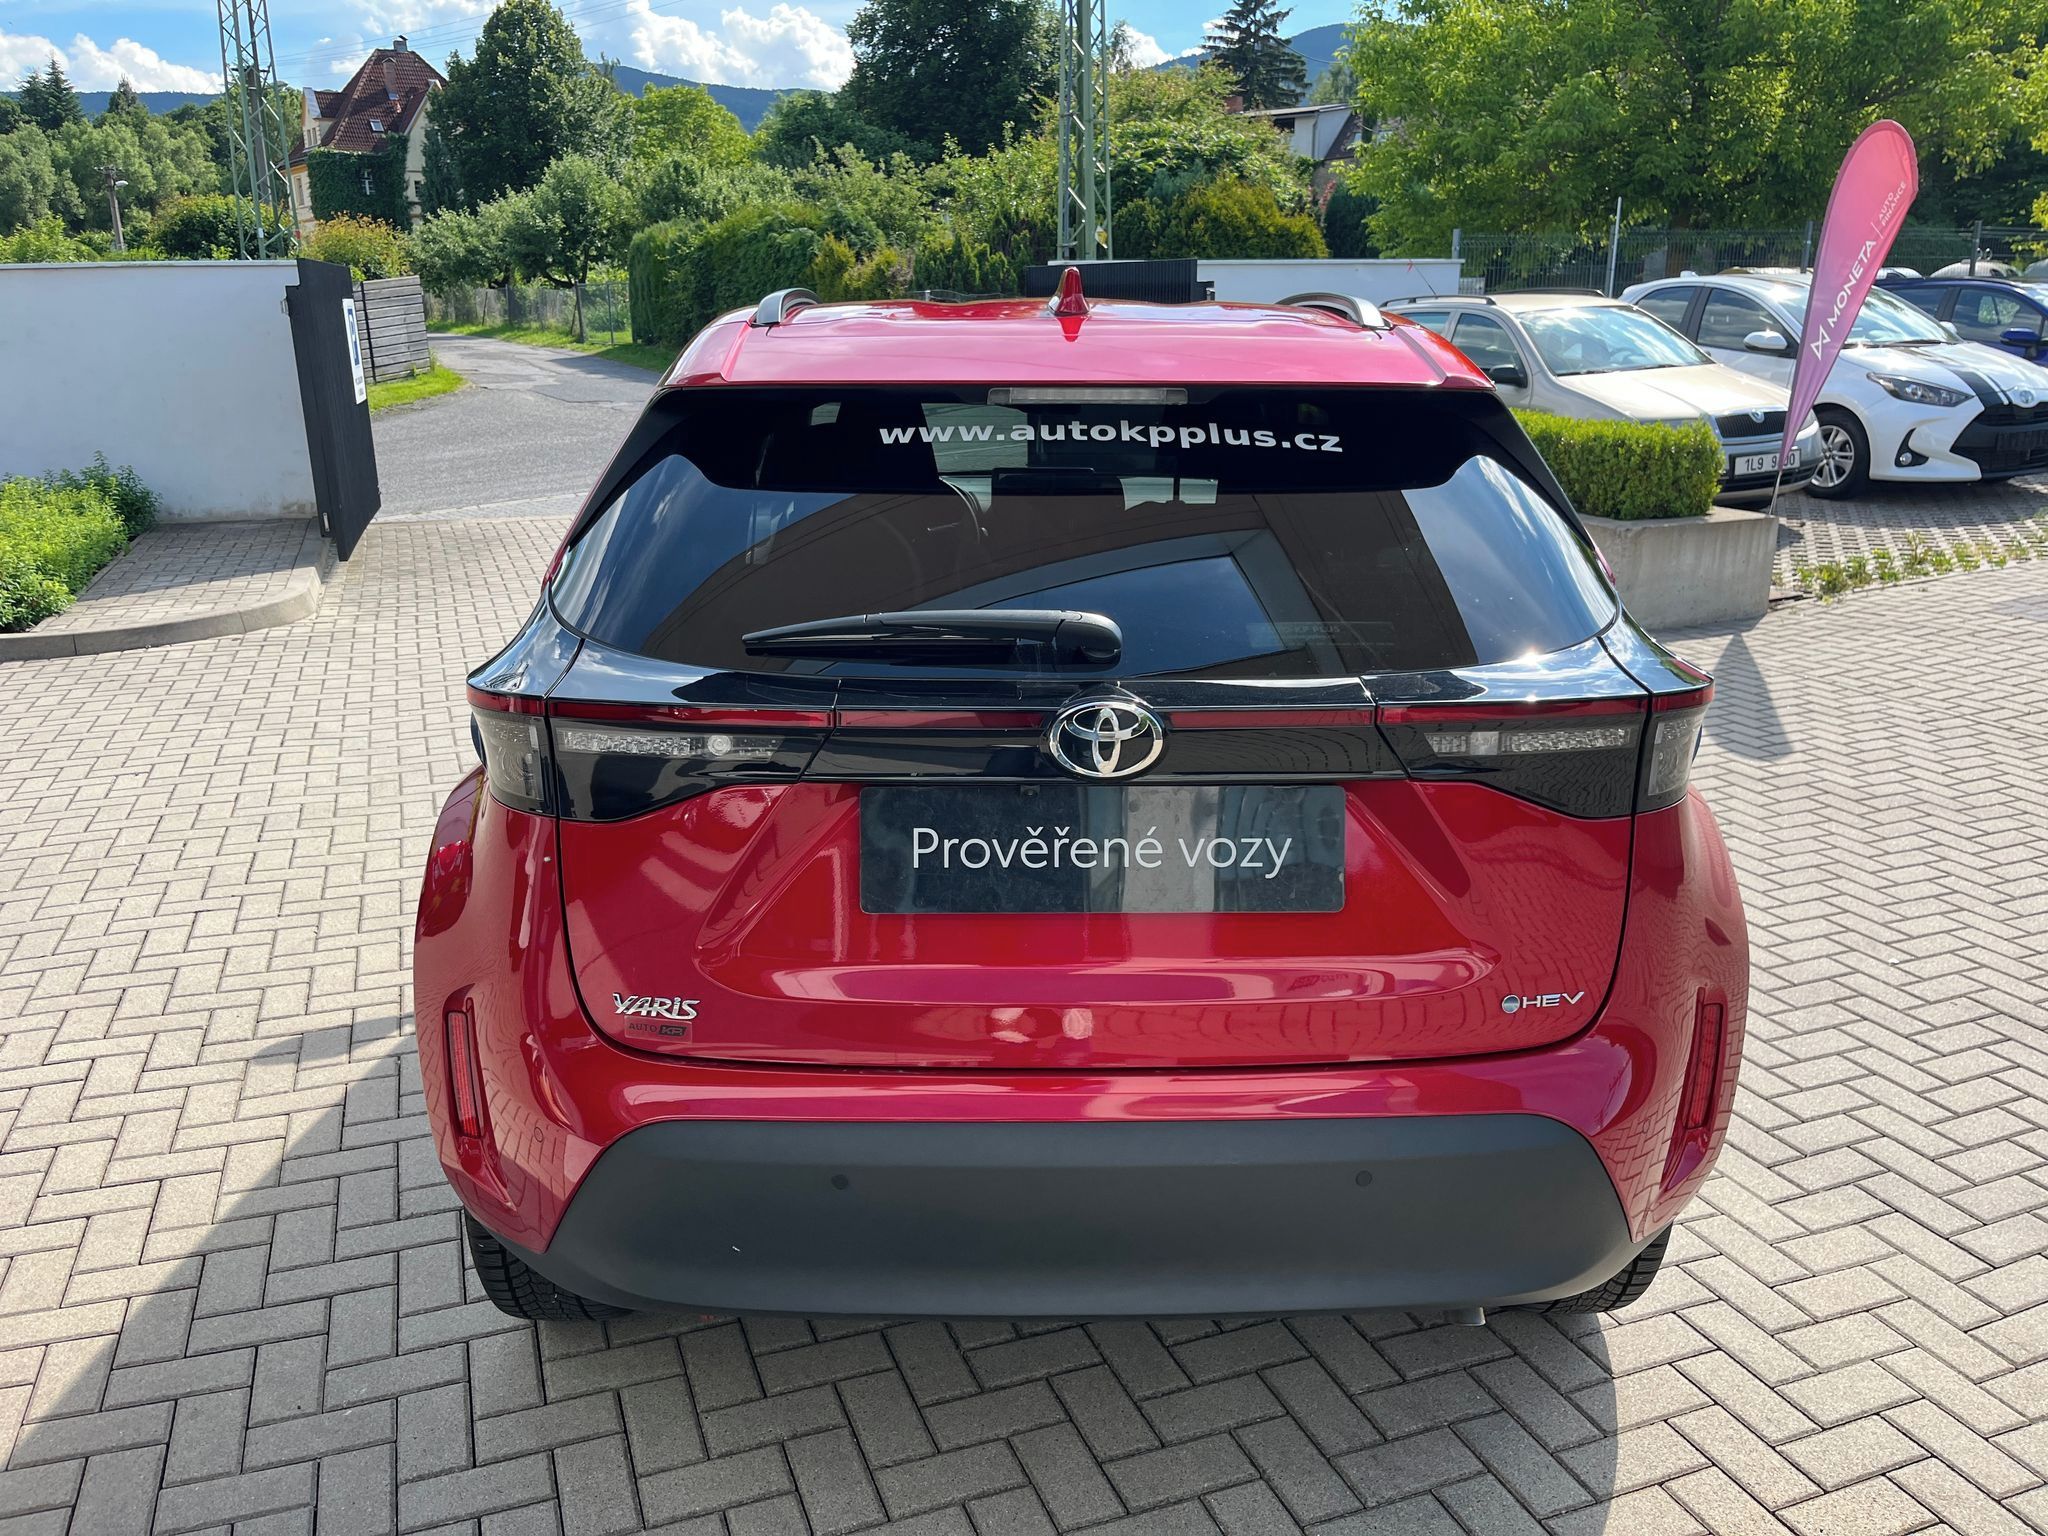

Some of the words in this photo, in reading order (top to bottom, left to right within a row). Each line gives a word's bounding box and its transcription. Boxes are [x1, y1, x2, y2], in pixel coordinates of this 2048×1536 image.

[1879, 192, 1894, 220] AUTO
[1881, 182, 1906, 226] FINANCE
[1827, 240, 1876, 328] MONETA
[879, 419, 1343, 453] www.autokpplus.cz
[1745, 457, 1764, 472] 1L9
[1771, 453, 1796, 469] 90
[912, 827, 1163, 869] Prověřené
[1178, 837, 1292, 879] vozy
[1522, 991, 1585, 1009] HEV
[629, 1023, 657, 1032] AUTO
